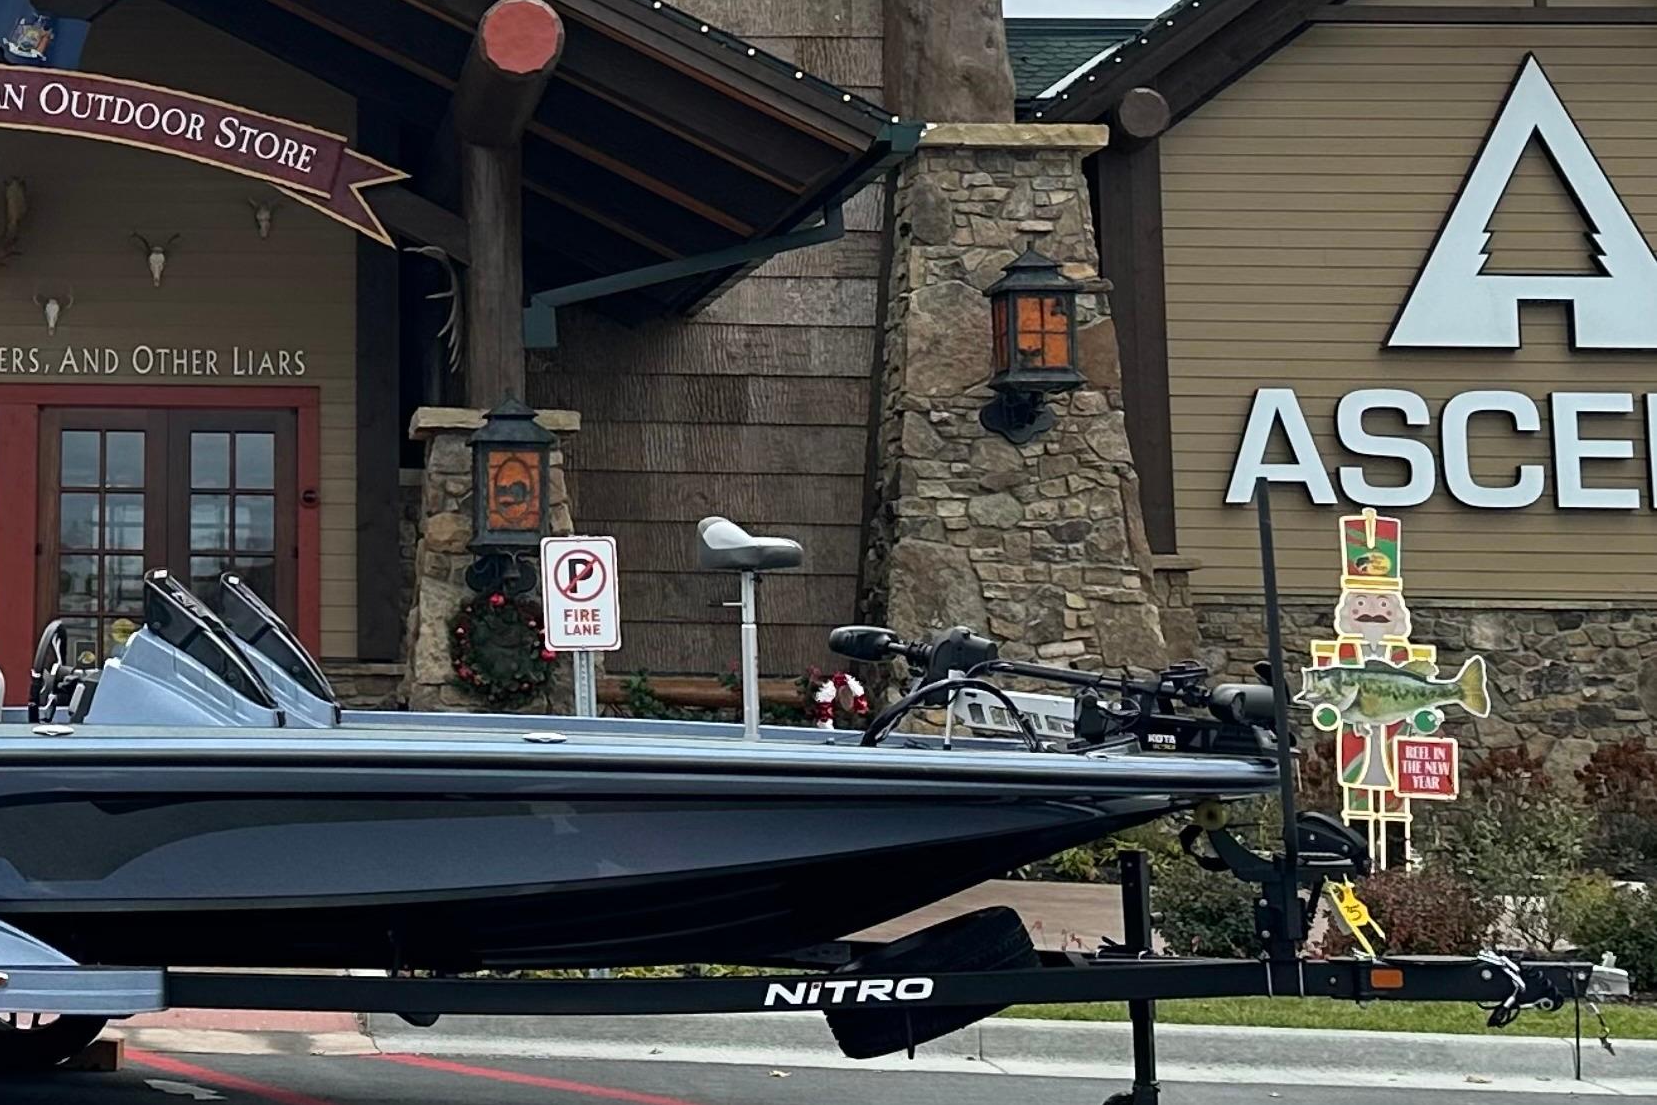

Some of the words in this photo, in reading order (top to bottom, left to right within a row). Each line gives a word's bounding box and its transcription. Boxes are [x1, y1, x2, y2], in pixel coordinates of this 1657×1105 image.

[39, 82, 203, 141] OUTDOOR
[213, 116, 317, 174] STORE
[58, 345, 120, 374] AND
[132, 344, 220, 375] OTHER
[232, 346, 306, 376] LIARS
[1225, 387, 1657, 508] ASCE
[563, 608, 601, 622] FIRE
[564, 624, 602, 635] LANE
[1405, 744, 1432, 760] REEL
[1433, 746, 1447, 761] IN
[1401, 759, 1424, 774] THE
[1425, 760, 1450, 775] NEW
[1411, 775, 1440, 790] YEAR
[763, 977, 935, 1006] NITRO
